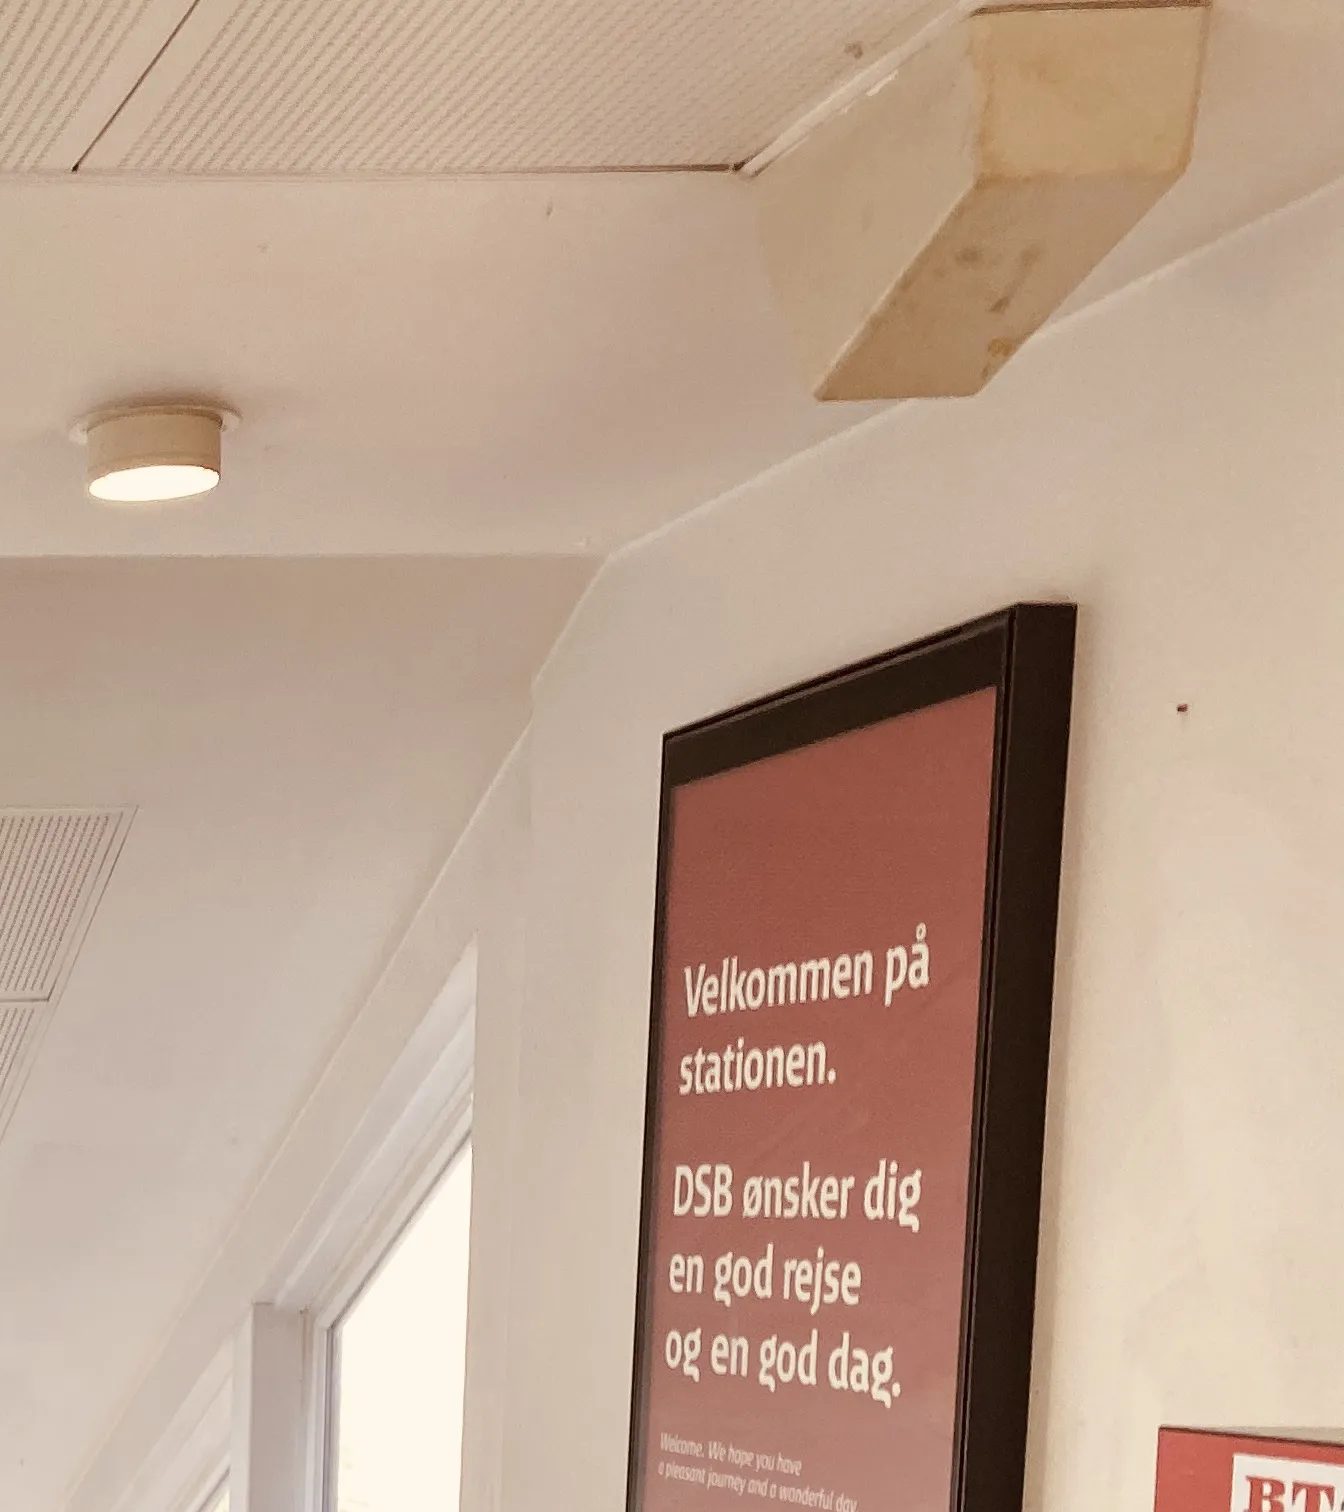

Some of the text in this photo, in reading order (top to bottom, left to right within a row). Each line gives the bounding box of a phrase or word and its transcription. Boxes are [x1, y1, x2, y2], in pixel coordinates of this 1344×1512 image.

[684, 923, 930, 1018] Velkommen på
[678, 1037, 837, 1096] stationen.
[673, 1158, 922, 1232] DSB ønsker dig
[669, 1242, 862, 1316] en god rejse
[665, 1328, 901, 1408] og en god dag.
[660, 1432, 803, 1477] Welcome. We hope you have
[665, 1461, 706, 1485] pleasant
[707, 1467, 746, 1497] journey
[747, 1478, 768, 1498] and
[769, 1484, 777, 1499] a
[779, 1484, 834, 1512] wonderful
